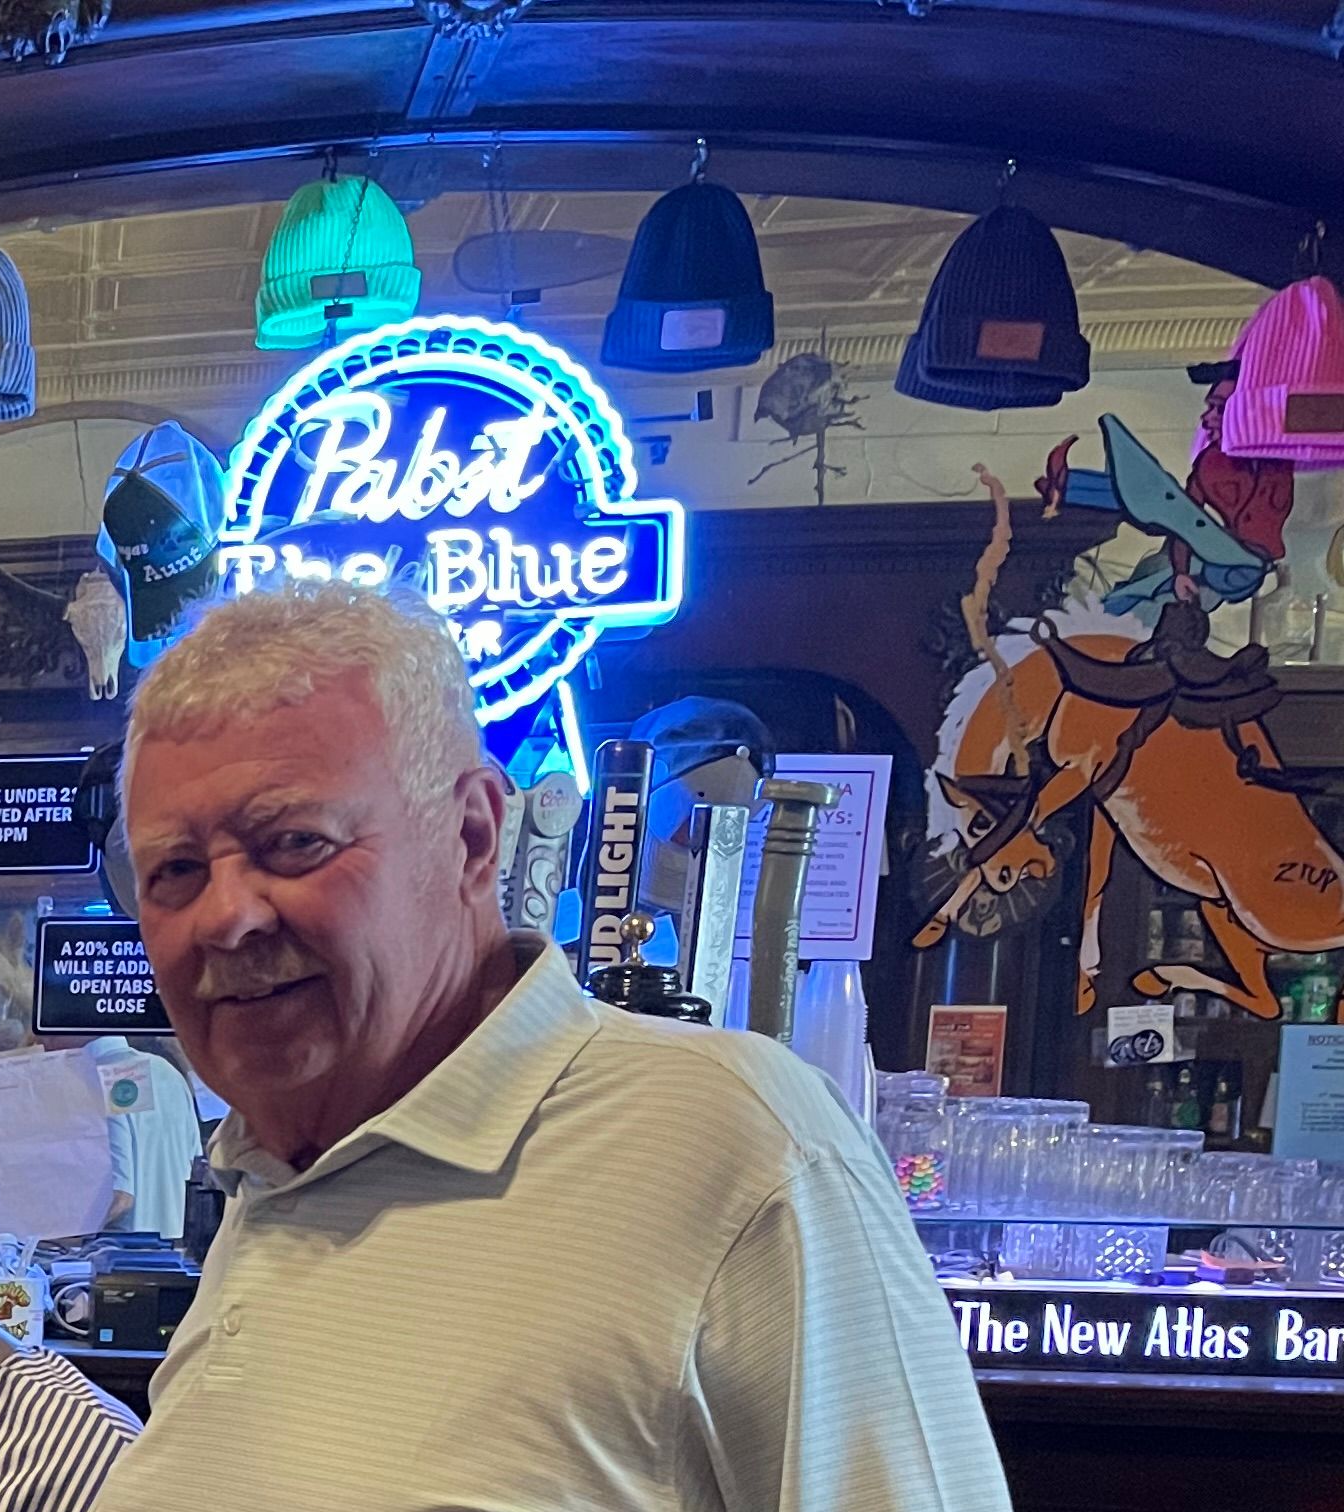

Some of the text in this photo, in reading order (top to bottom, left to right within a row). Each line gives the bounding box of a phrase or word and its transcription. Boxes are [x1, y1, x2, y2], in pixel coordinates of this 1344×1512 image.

[291, 391, 557, 523] Pabst
[427, 527, 629, 607] Blue
[4, 787, 57, 804] UNDER
[24, 806, 73, 823] AFTER
[588, 786, 640, 966] UD LIGHT
[61, 941, 146, 956] A 20% GRA
[53, 959, 90, 975] WILL
[93, 959, 114, 975] BE
[70, 979, 154, 994] OPEN TABS
[96, 998, 146, 1014] CLOSE
[953, 1300, 1344, 1362] The New Atlas Bar
